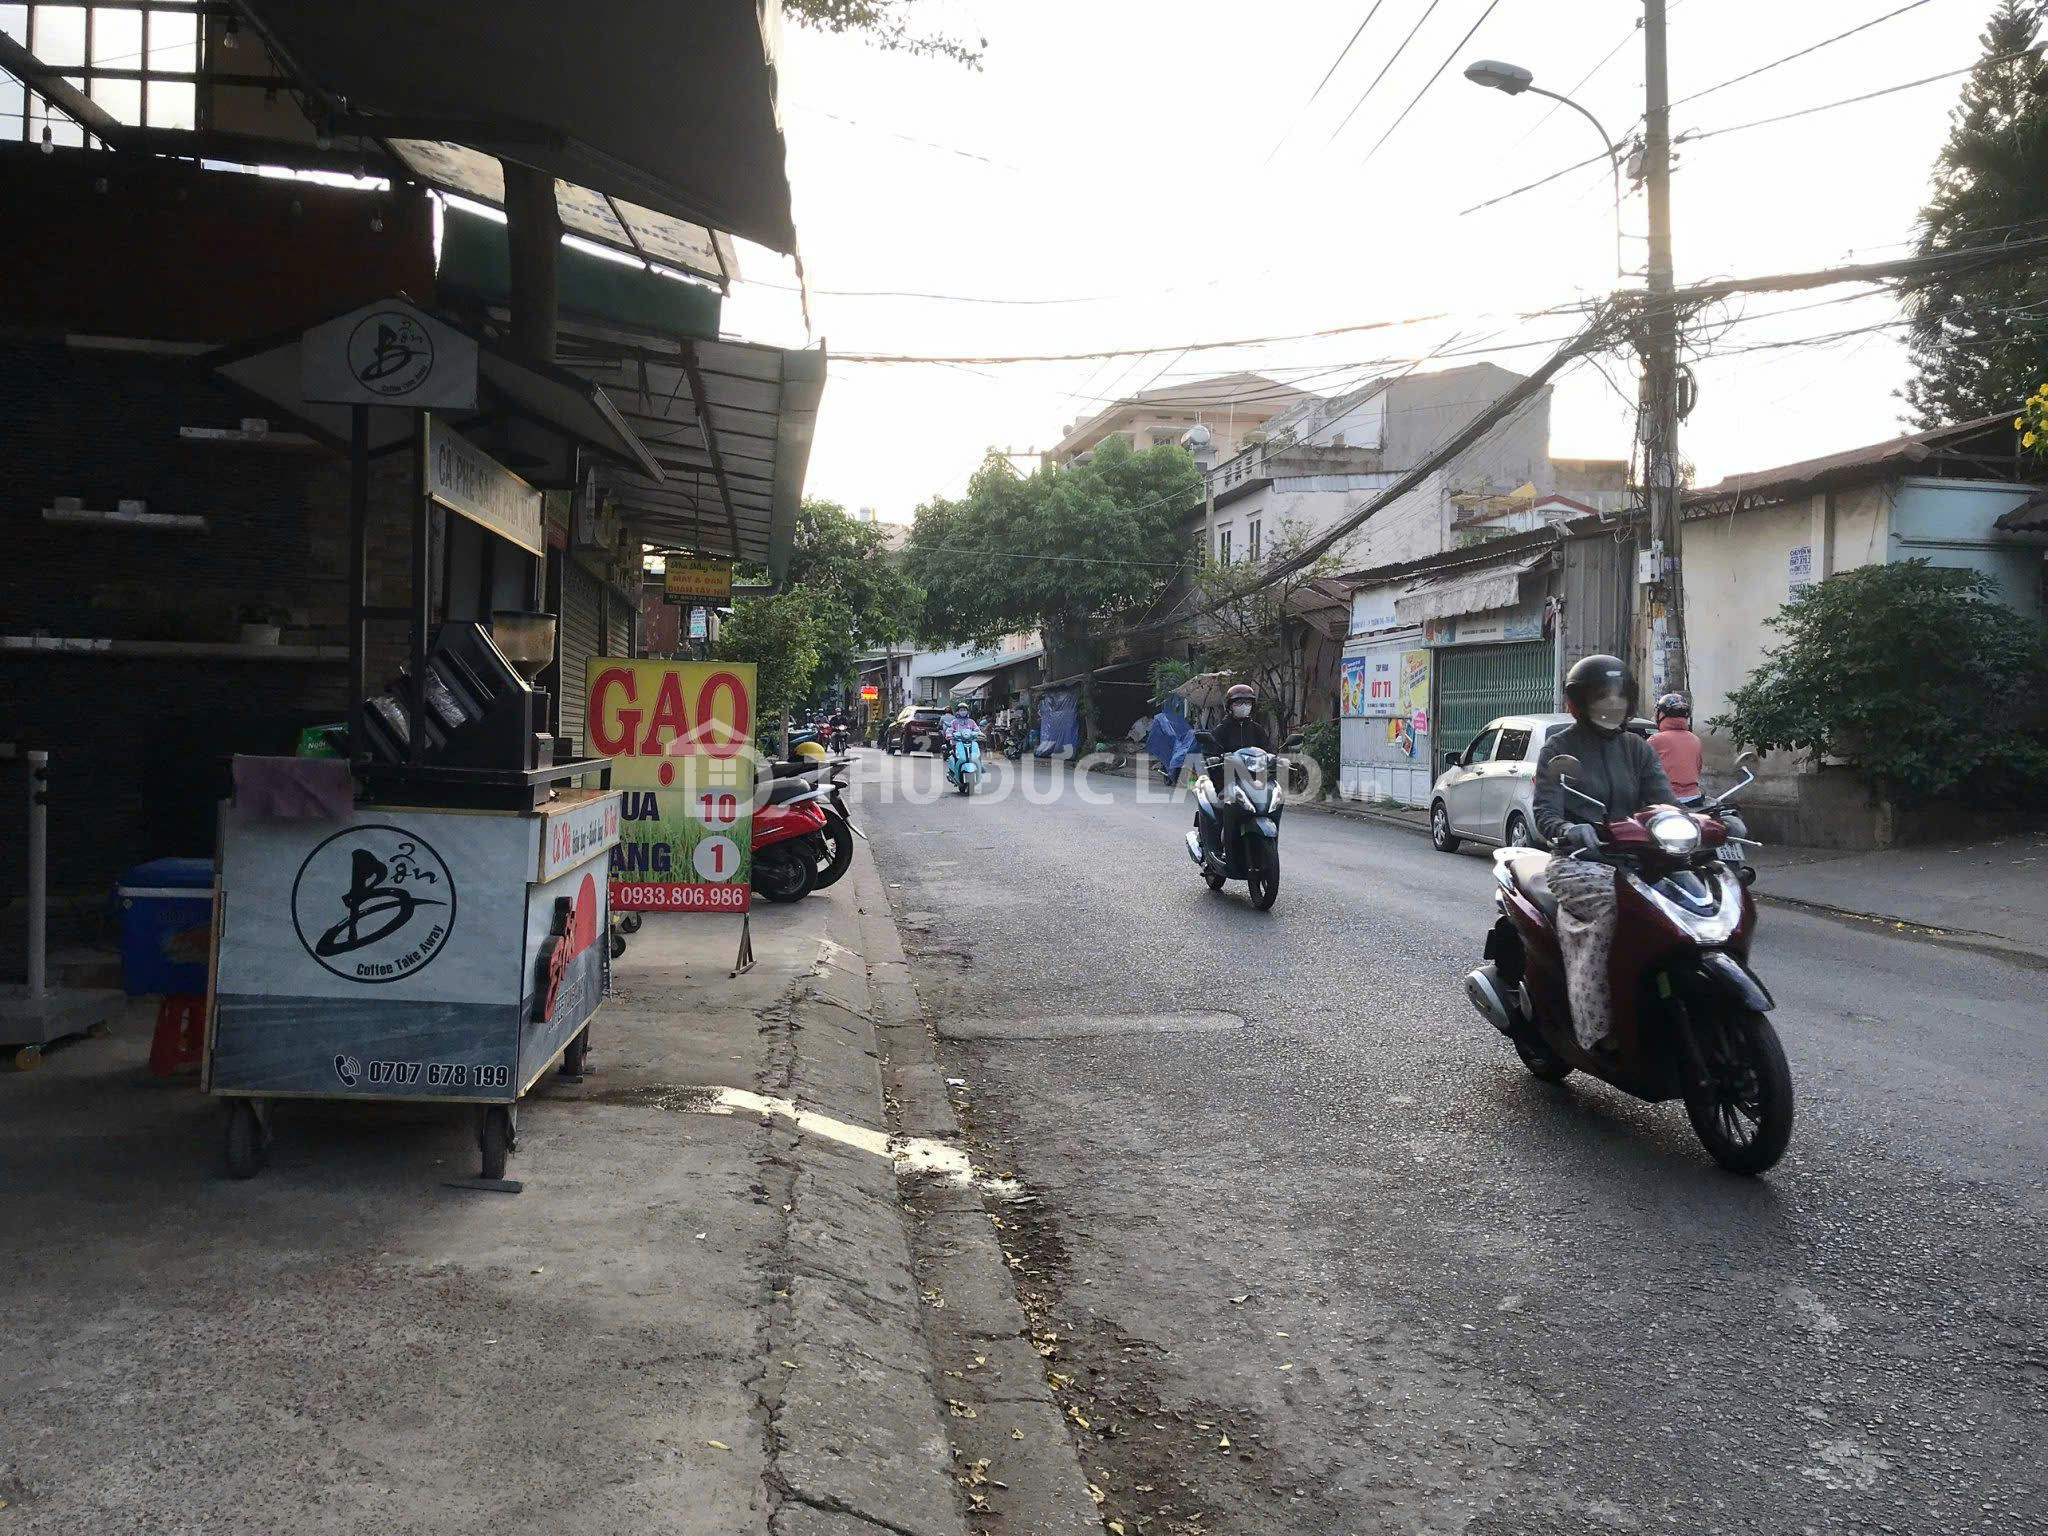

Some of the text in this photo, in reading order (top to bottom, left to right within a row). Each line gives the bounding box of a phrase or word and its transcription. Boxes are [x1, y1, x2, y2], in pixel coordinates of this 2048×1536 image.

[588, 667, 751, 787] GẠO
[621, 791, 737, 823] UA 10
[710, 844, 724, 873] 1
[621, 886, 743, 906] 0933.806.986
[356, 924, 445, 976] Coffee Take Away
[368, 1061, 508, 1087] 0707 678 199
